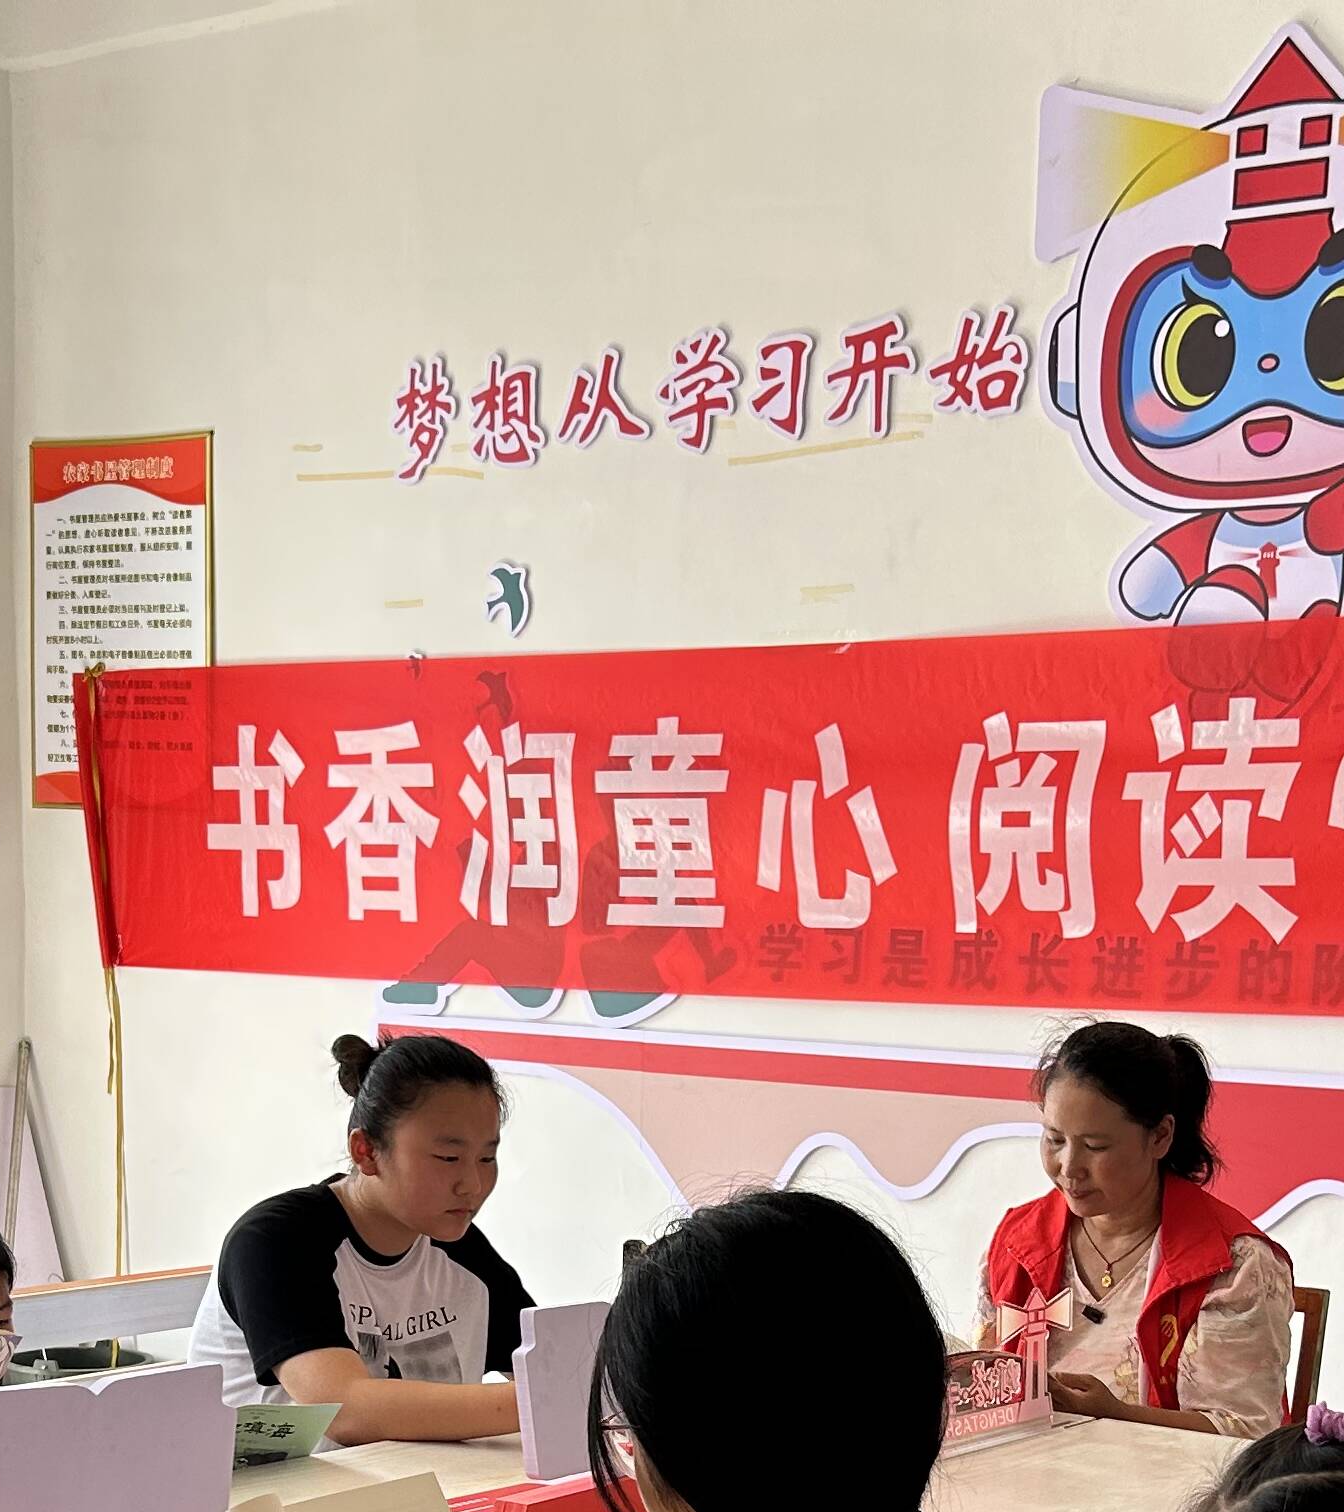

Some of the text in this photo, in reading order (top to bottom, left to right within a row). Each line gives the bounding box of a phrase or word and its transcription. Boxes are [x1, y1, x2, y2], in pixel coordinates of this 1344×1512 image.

[395, 305, 1026, 482] 梦想从学习开始
[63, 456, 174, 483] 农家书屋管理制度
[207, 714, 899, 932] 书香润童心
[407, 1306, 458, 1336] GIRL
[236, 1420, 297, 1439] 填海
